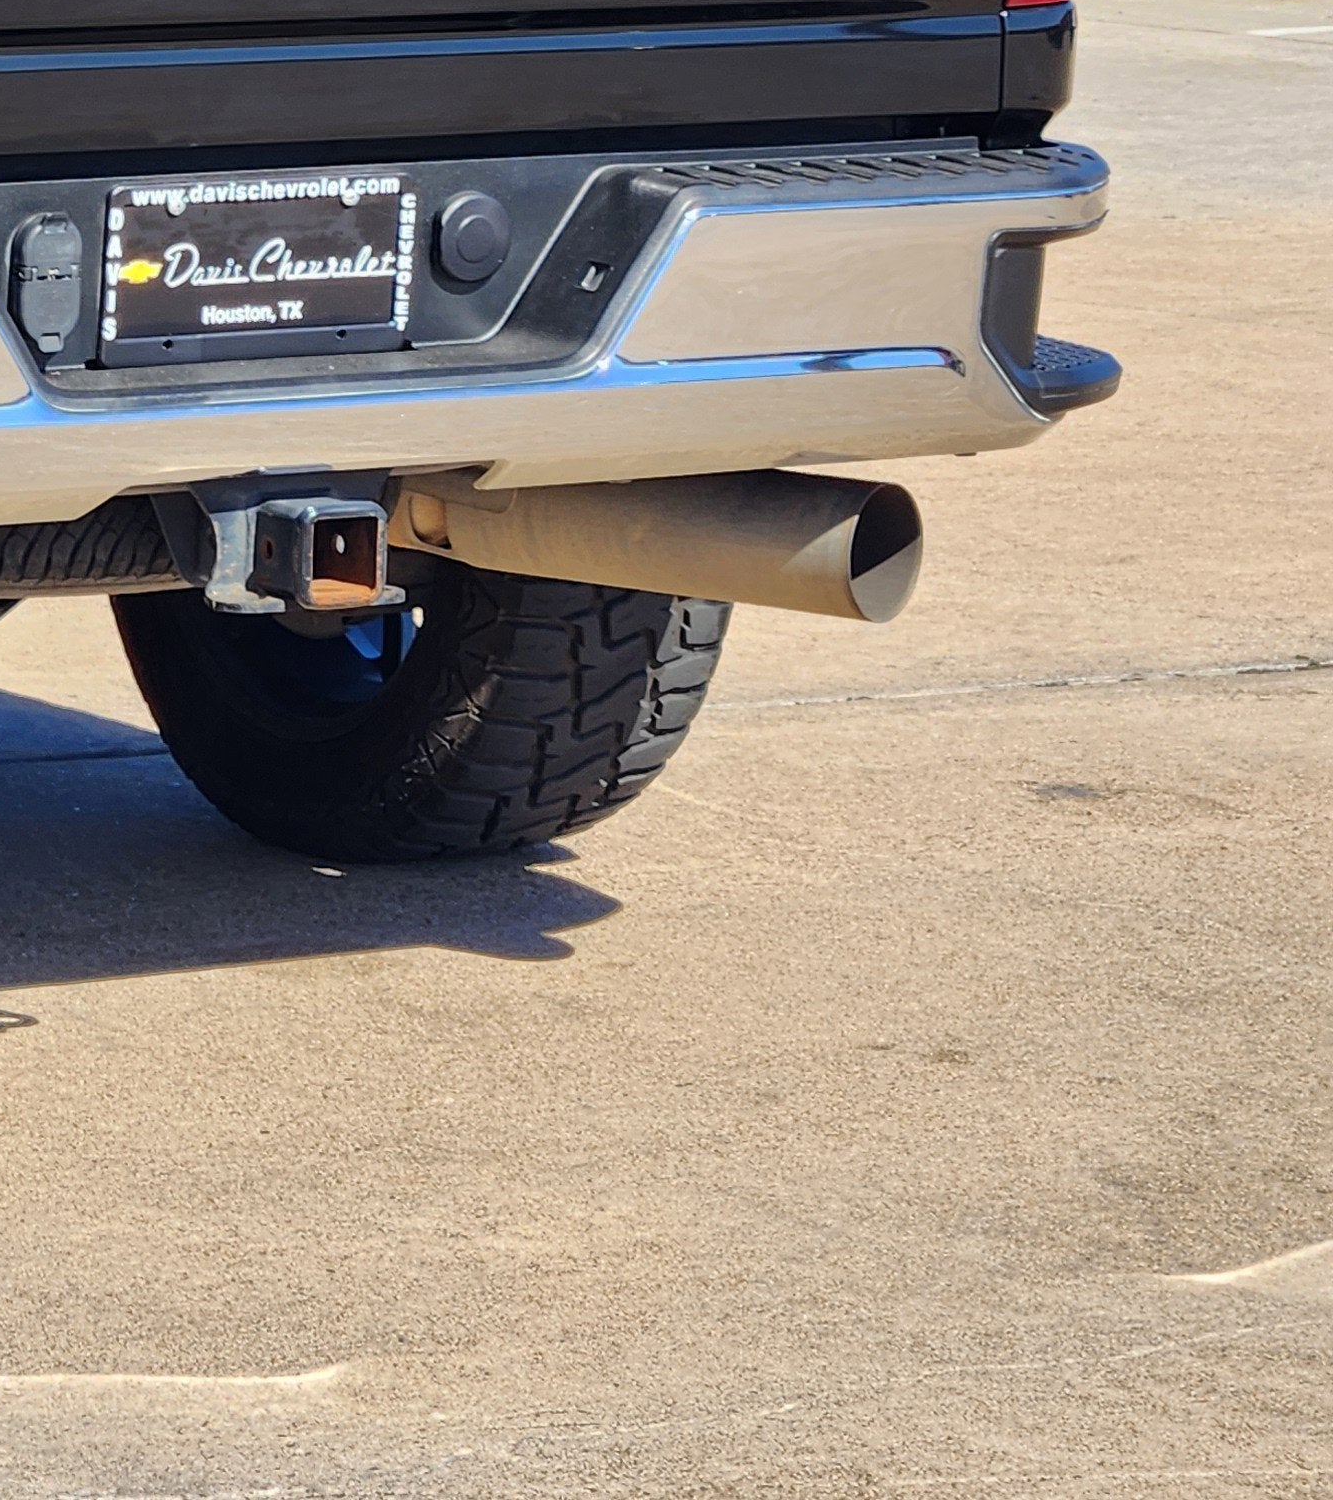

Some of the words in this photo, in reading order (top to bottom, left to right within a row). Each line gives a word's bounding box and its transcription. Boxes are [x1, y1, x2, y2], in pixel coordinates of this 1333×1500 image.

[130, 176, 401, 208] www.davischevrolet.com
[101, 206, 125, 342] DAVIS
[162, 242, 250, 288] Davis
[249, 236, 398, 283] Chevrolet
[392, 192, 417, 332] CHEVROLET
[201, 304, 277, 326] Houston,
[277, 299, 304, 321] TX
